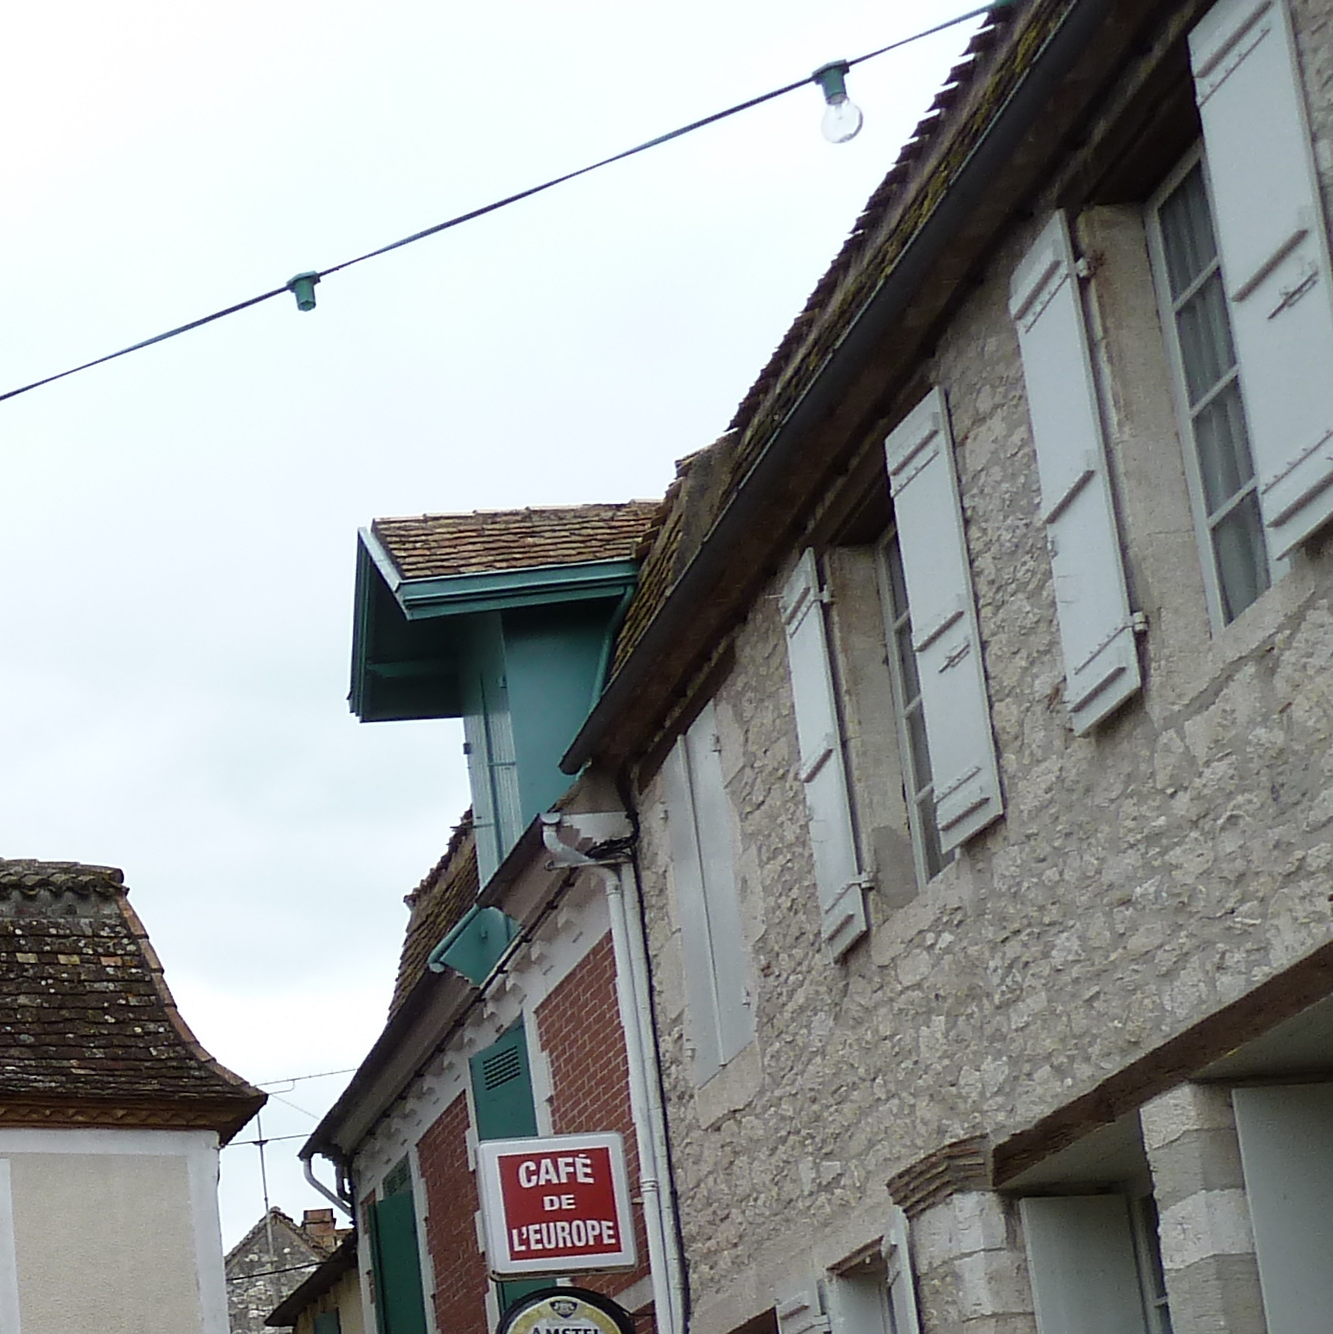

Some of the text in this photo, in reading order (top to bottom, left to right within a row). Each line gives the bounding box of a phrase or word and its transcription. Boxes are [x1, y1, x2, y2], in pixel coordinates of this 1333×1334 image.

[518, 1153, 594, 1188] CAFÉ
[543, 1194, 576, 1211] DE
[511, 1219, 616, 1252] L'EUROPE
